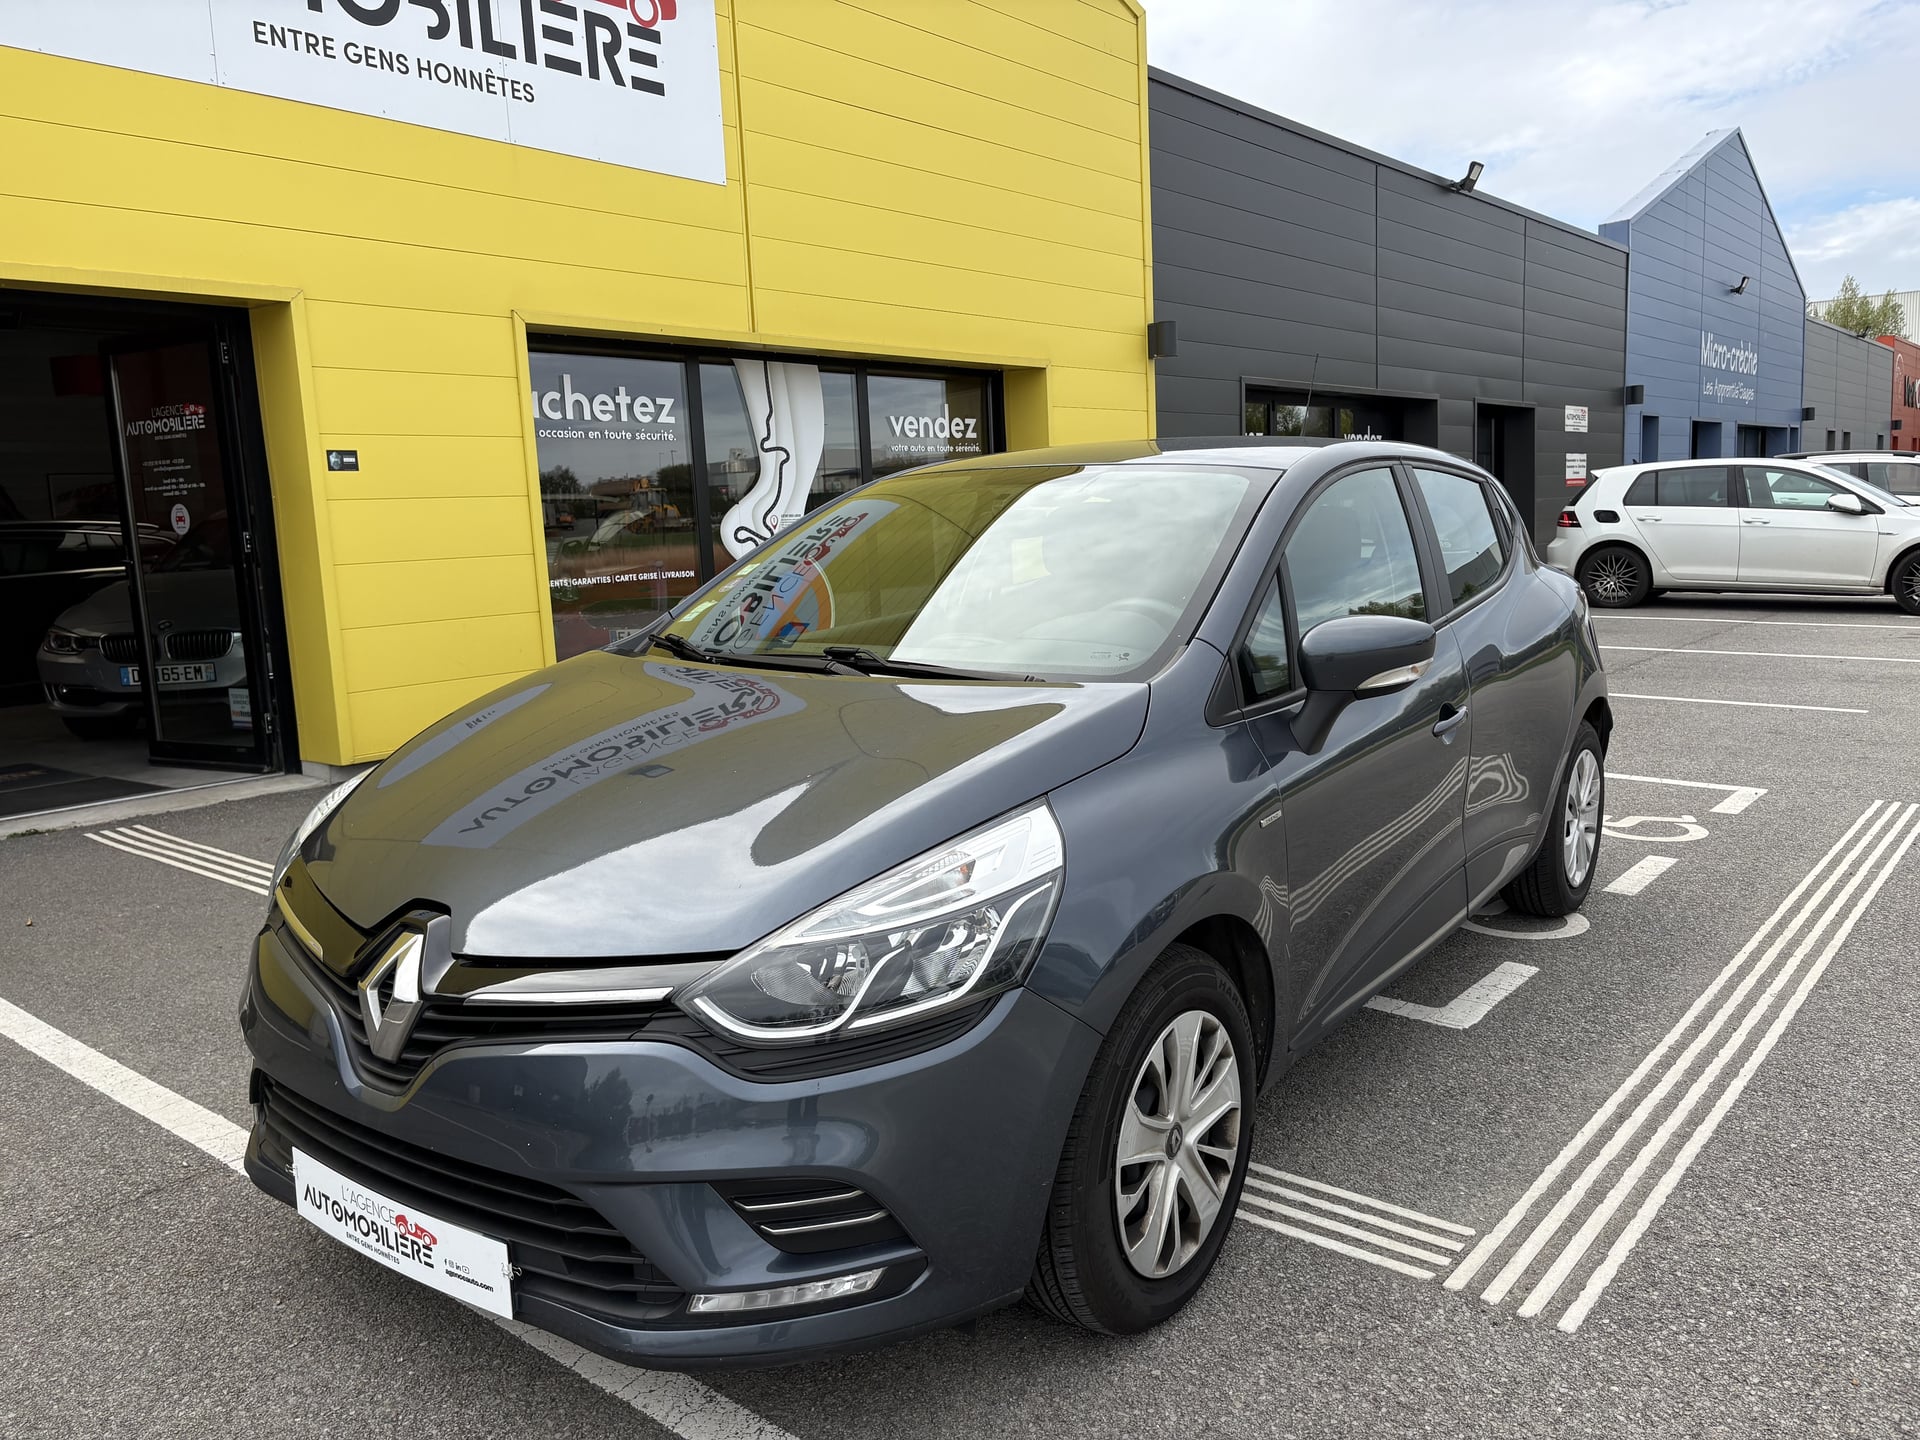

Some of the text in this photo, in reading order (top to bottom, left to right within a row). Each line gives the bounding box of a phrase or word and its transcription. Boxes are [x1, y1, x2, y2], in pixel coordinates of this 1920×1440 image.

[252, 20, 536, 103] ENTRE GENS HONNÊTES
[1700, 331, 1758, 376] Micro-crèche
[538, 427, 677, 442] occasion en toute sécurité.
[889, 404, 977, 439] vendez
[890, 444, 909, 453] votre
[910, 444, 926, 453] auto
[927, 445, 936, 453] en
[937, 444, 954, 453] toute
[571, 576, 612, 586] GARANTIES
[615, 575, 638, 583] CARTE
[638, 573, 658, 581] GRISE
[661, 570, 696, 580] LIVRAISON
[341, 1184, 396, 1226] L'AGENCE
[303, 1183, 435, 1269] AUTOMOBILIERE
[346, 1231, 400, 1265] ENTRE GENS HONNÊTES
